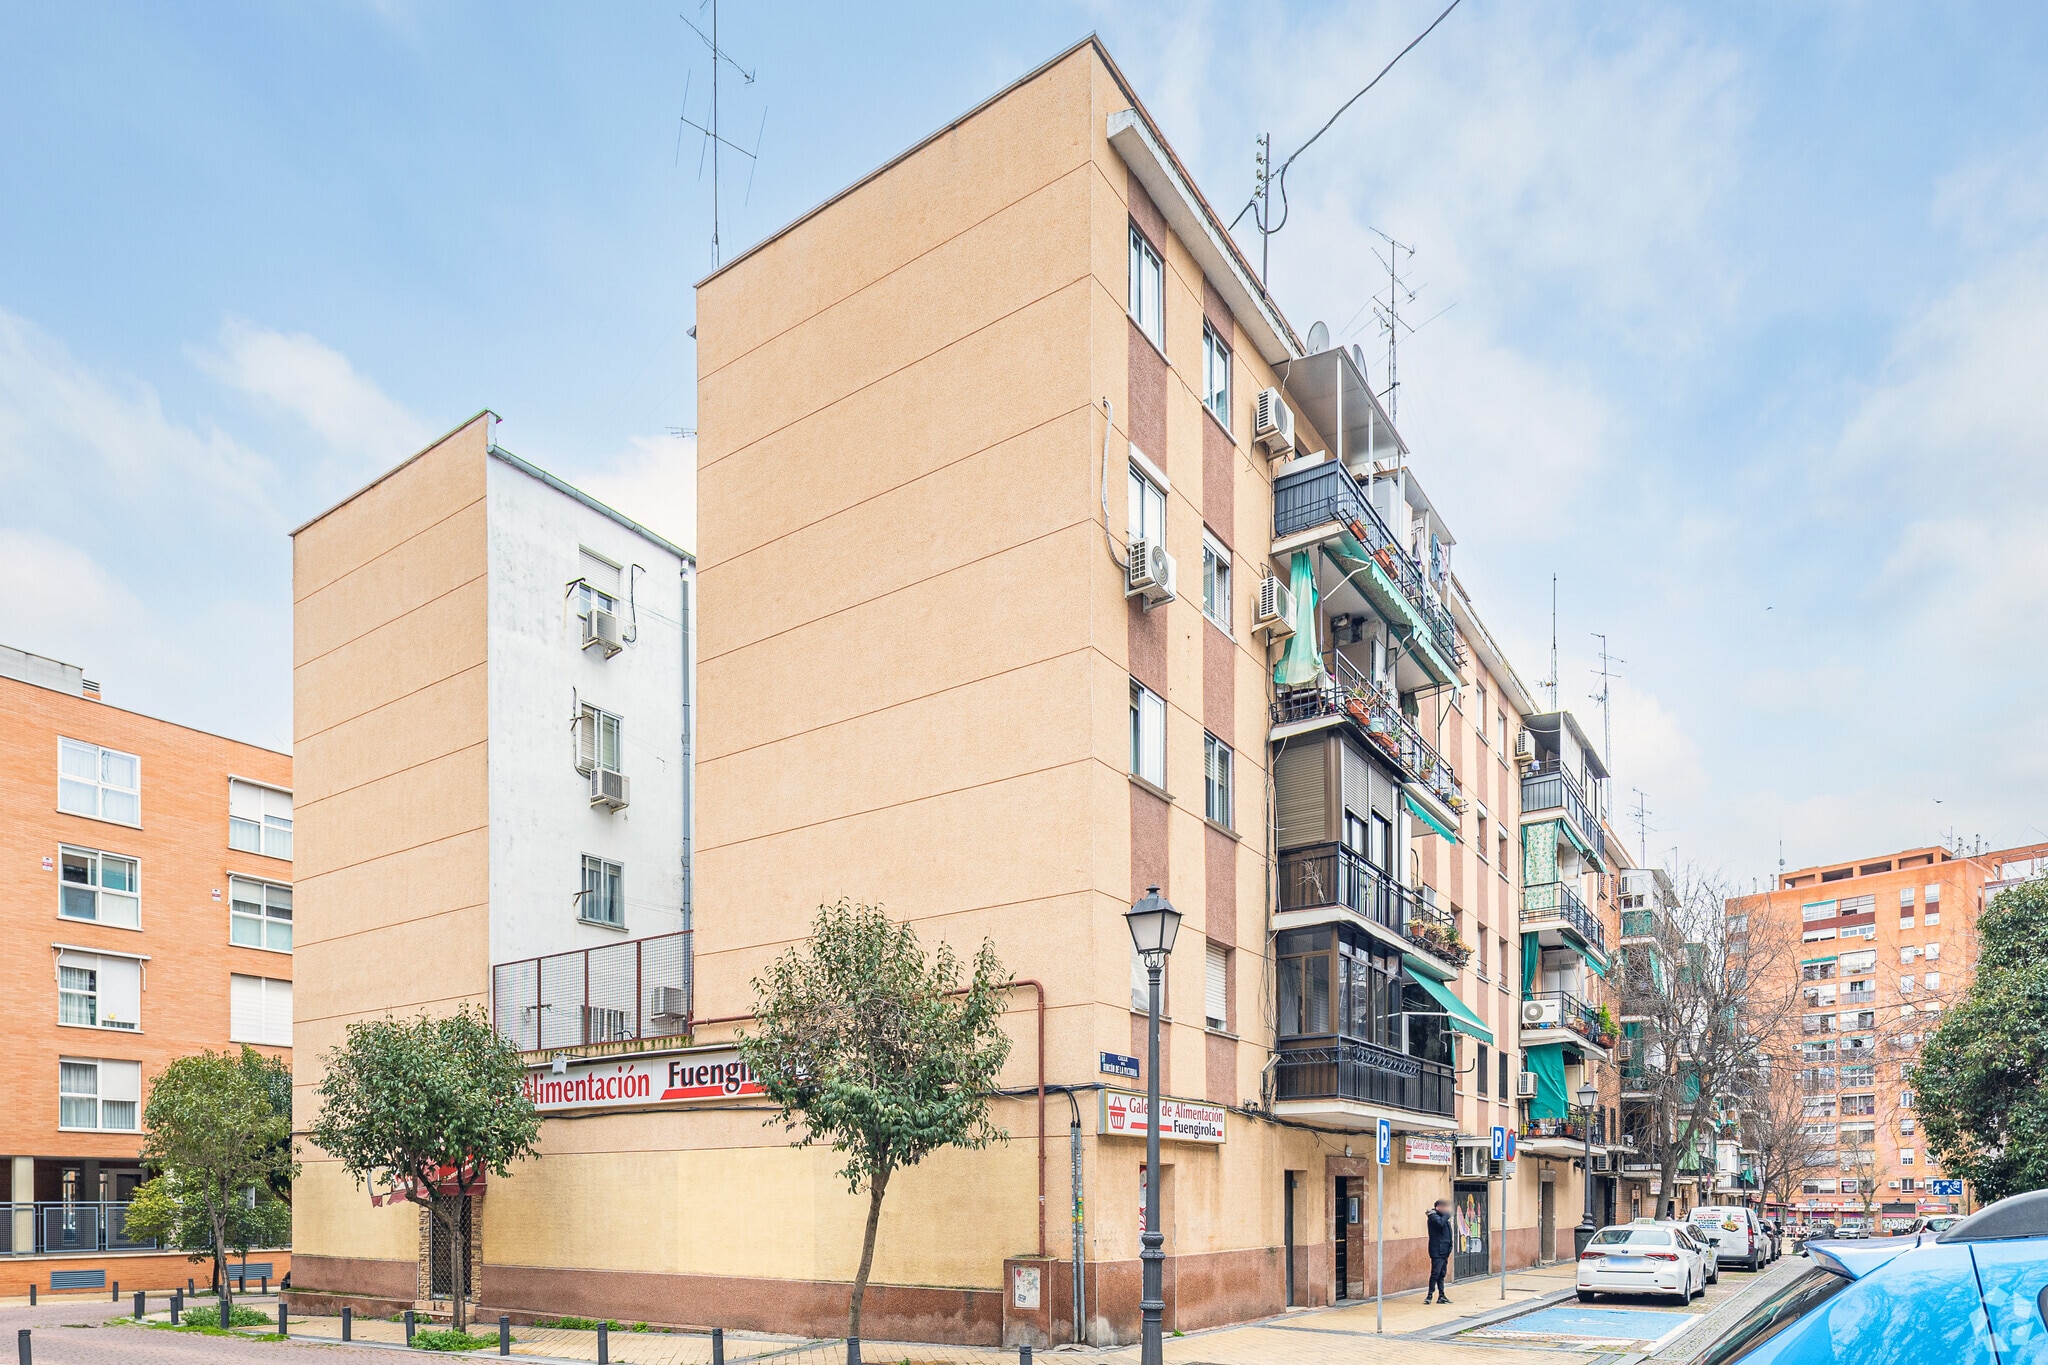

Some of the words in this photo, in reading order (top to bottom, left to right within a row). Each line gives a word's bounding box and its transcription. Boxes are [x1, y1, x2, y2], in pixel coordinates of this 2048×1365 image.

[1129, 1097, 1149, 1115] Gale
[1161, 1100, 1172, 1117] de
[1174, 1102, 1223, 1123] Alimentación
[1174, 1120, 1216, 1139] Fuengirola
[1380, 1125, 1388, 1158] P
[1495, 1130, 1502, 1156] P
